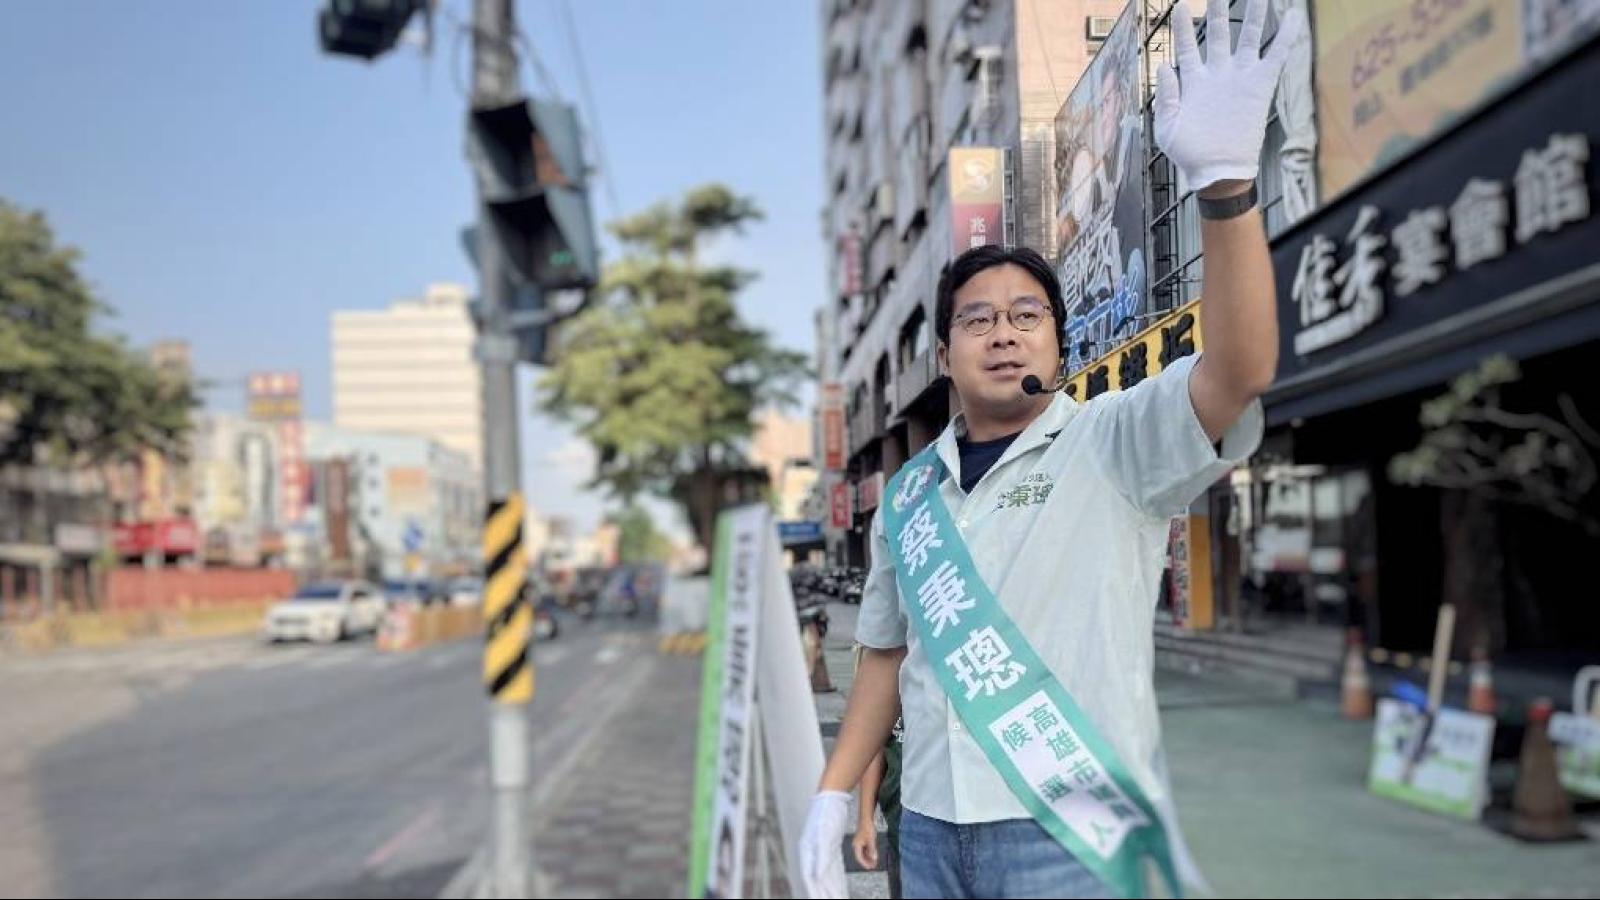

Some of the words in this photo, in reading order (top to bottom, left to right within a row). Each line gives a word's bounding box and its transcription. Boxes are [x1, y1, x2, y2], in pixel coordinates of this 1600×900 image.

[1291, 132, 1591, 356] 佳秀宴會館
[1002, 721, 1115, 848] 候選人
